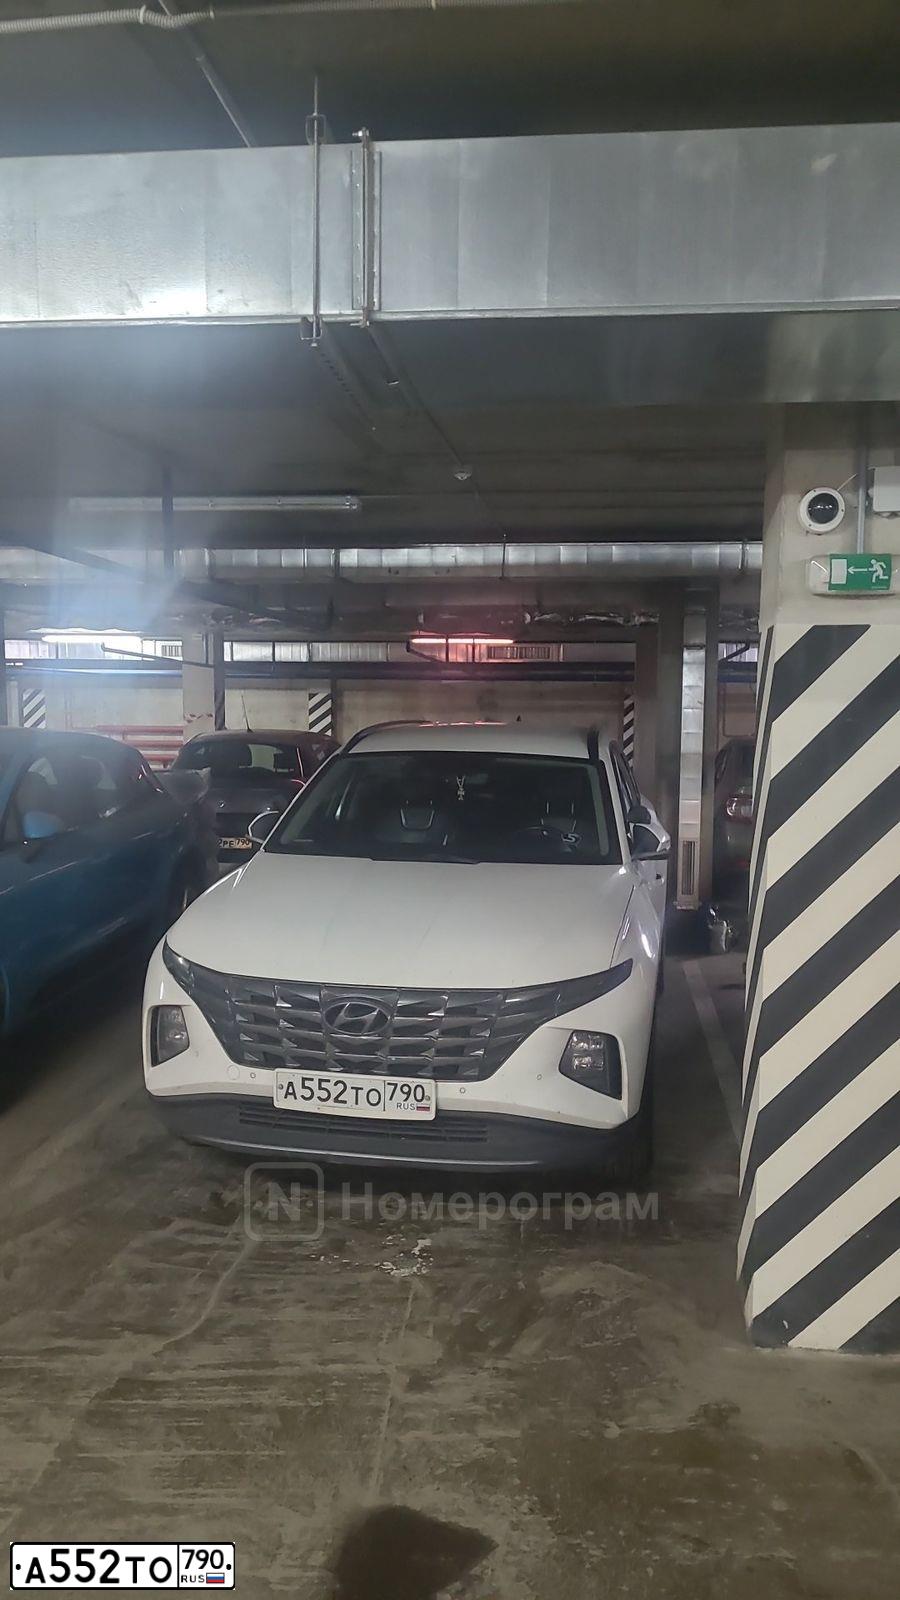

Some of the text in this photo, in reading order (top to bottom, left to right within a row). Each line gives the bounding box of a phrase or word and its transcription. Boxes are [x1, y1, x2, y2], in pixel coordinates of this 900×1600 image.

[283, 1077, 425, 1107] А552ТО 790
[396, 1102, 415, 1111] RUS
